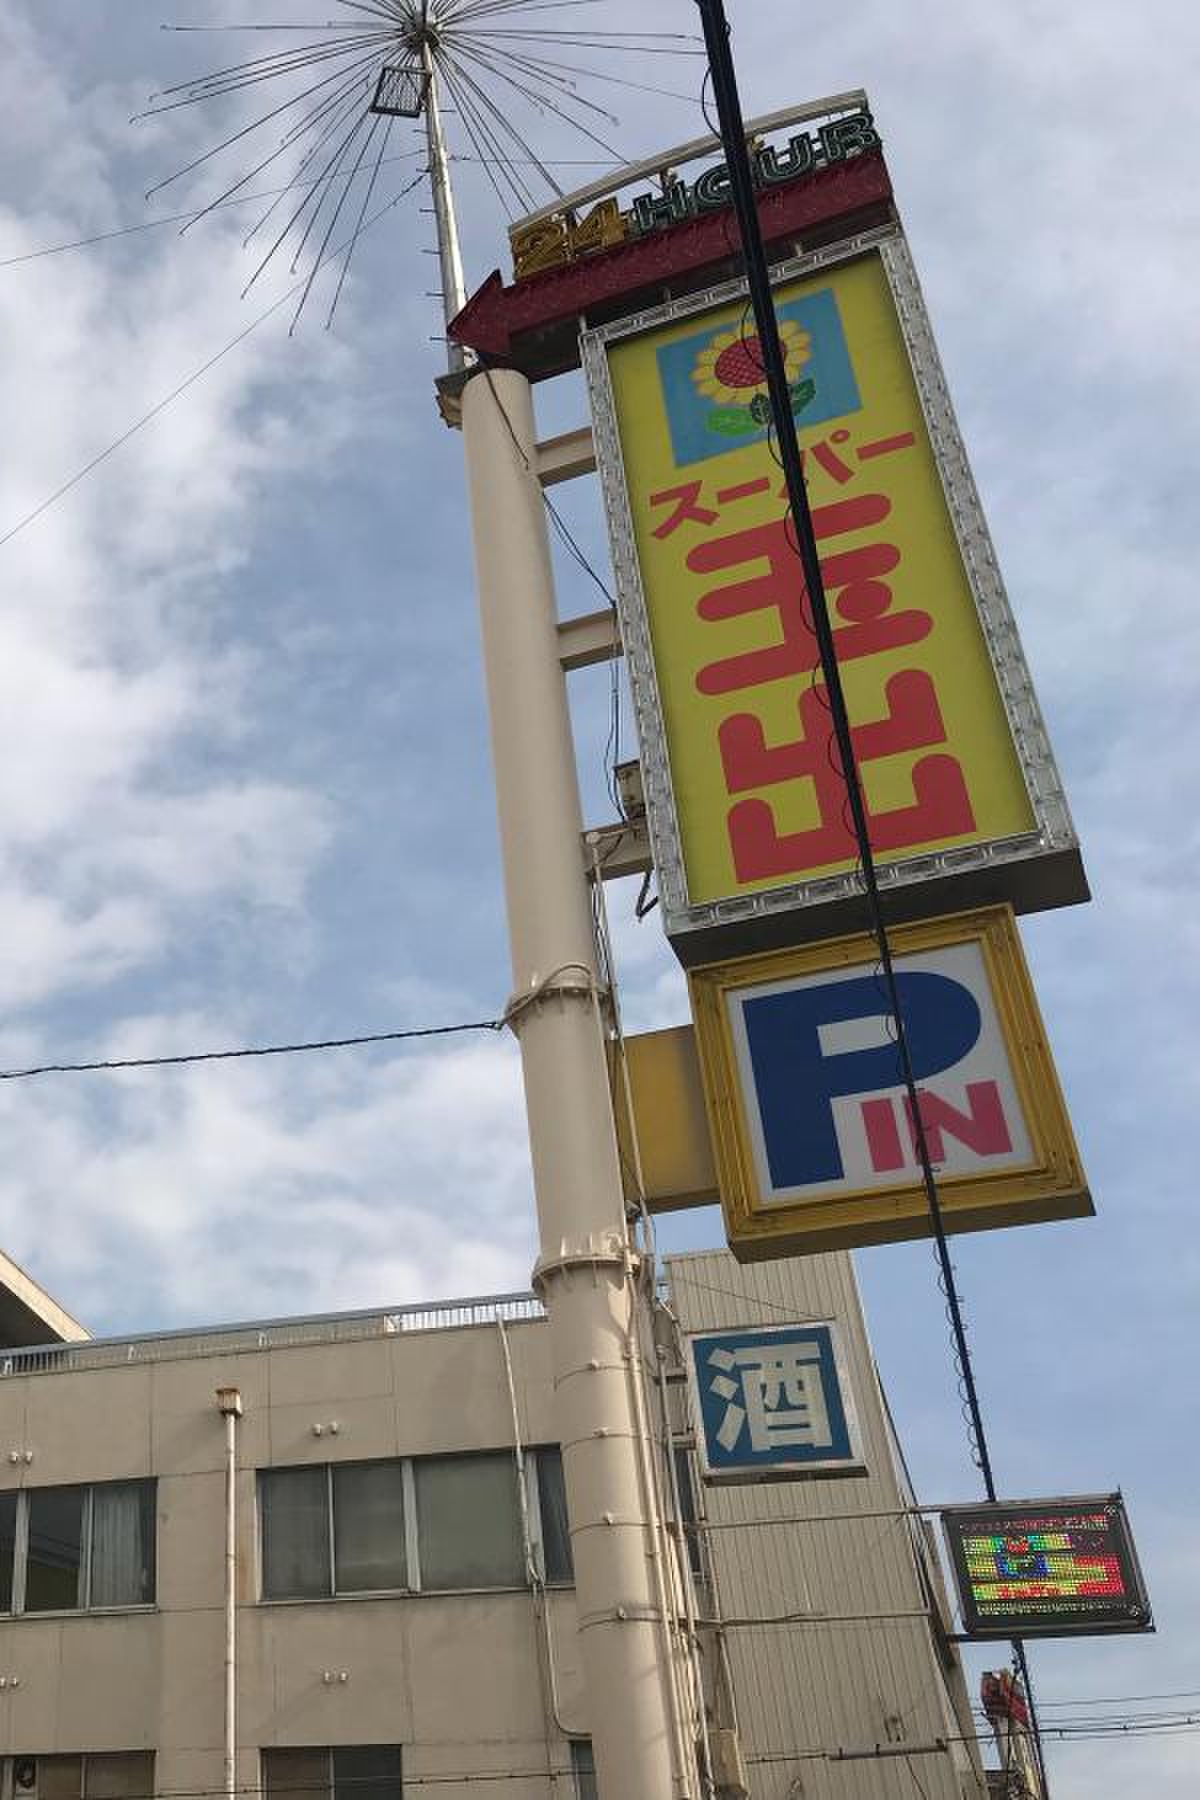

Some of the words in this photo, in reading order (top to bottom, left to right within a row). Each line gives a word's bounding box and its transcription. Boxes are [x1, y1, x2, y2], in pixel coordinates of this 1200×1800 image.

[632, 112, 883, 236] HOUR
[648, 428, 916, 539] スーパー
[686, 493, 977, 884] 玉出
[741, 971, 982, 1189] P
[860, 1079, 1013, 1173] IN
[707, 1342, 833, 1451] 酒
